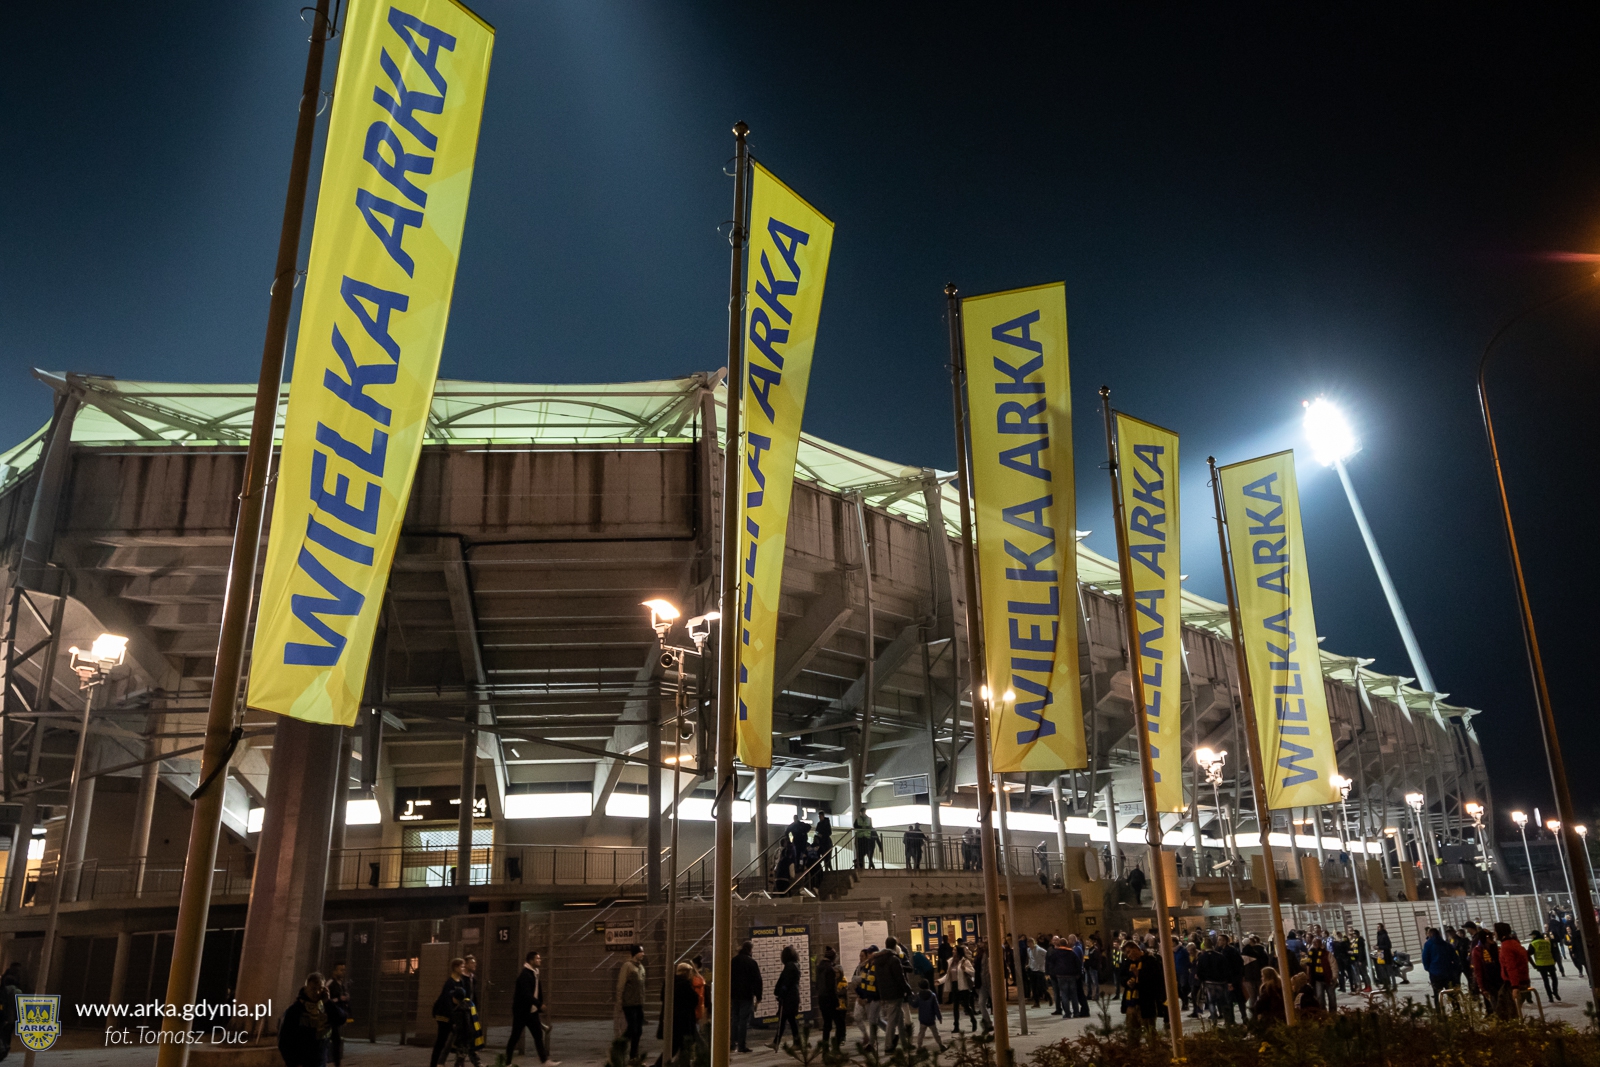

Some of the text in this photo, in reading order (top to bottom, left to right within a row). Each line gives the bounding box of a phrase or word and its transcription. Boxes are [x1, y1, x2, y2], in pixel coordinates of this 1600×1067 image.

[284, 7, 457, 666] WIELKA ARKA
[748, 217, 809, 424] ARKA
[992, 310, 1059, 744] WIELKA ARKA
[1130, 444, 1165, 579] ARKA
[1243, 472, 1318, 788] WIELKA ARKA
[499, 929, 509, 941] 15
